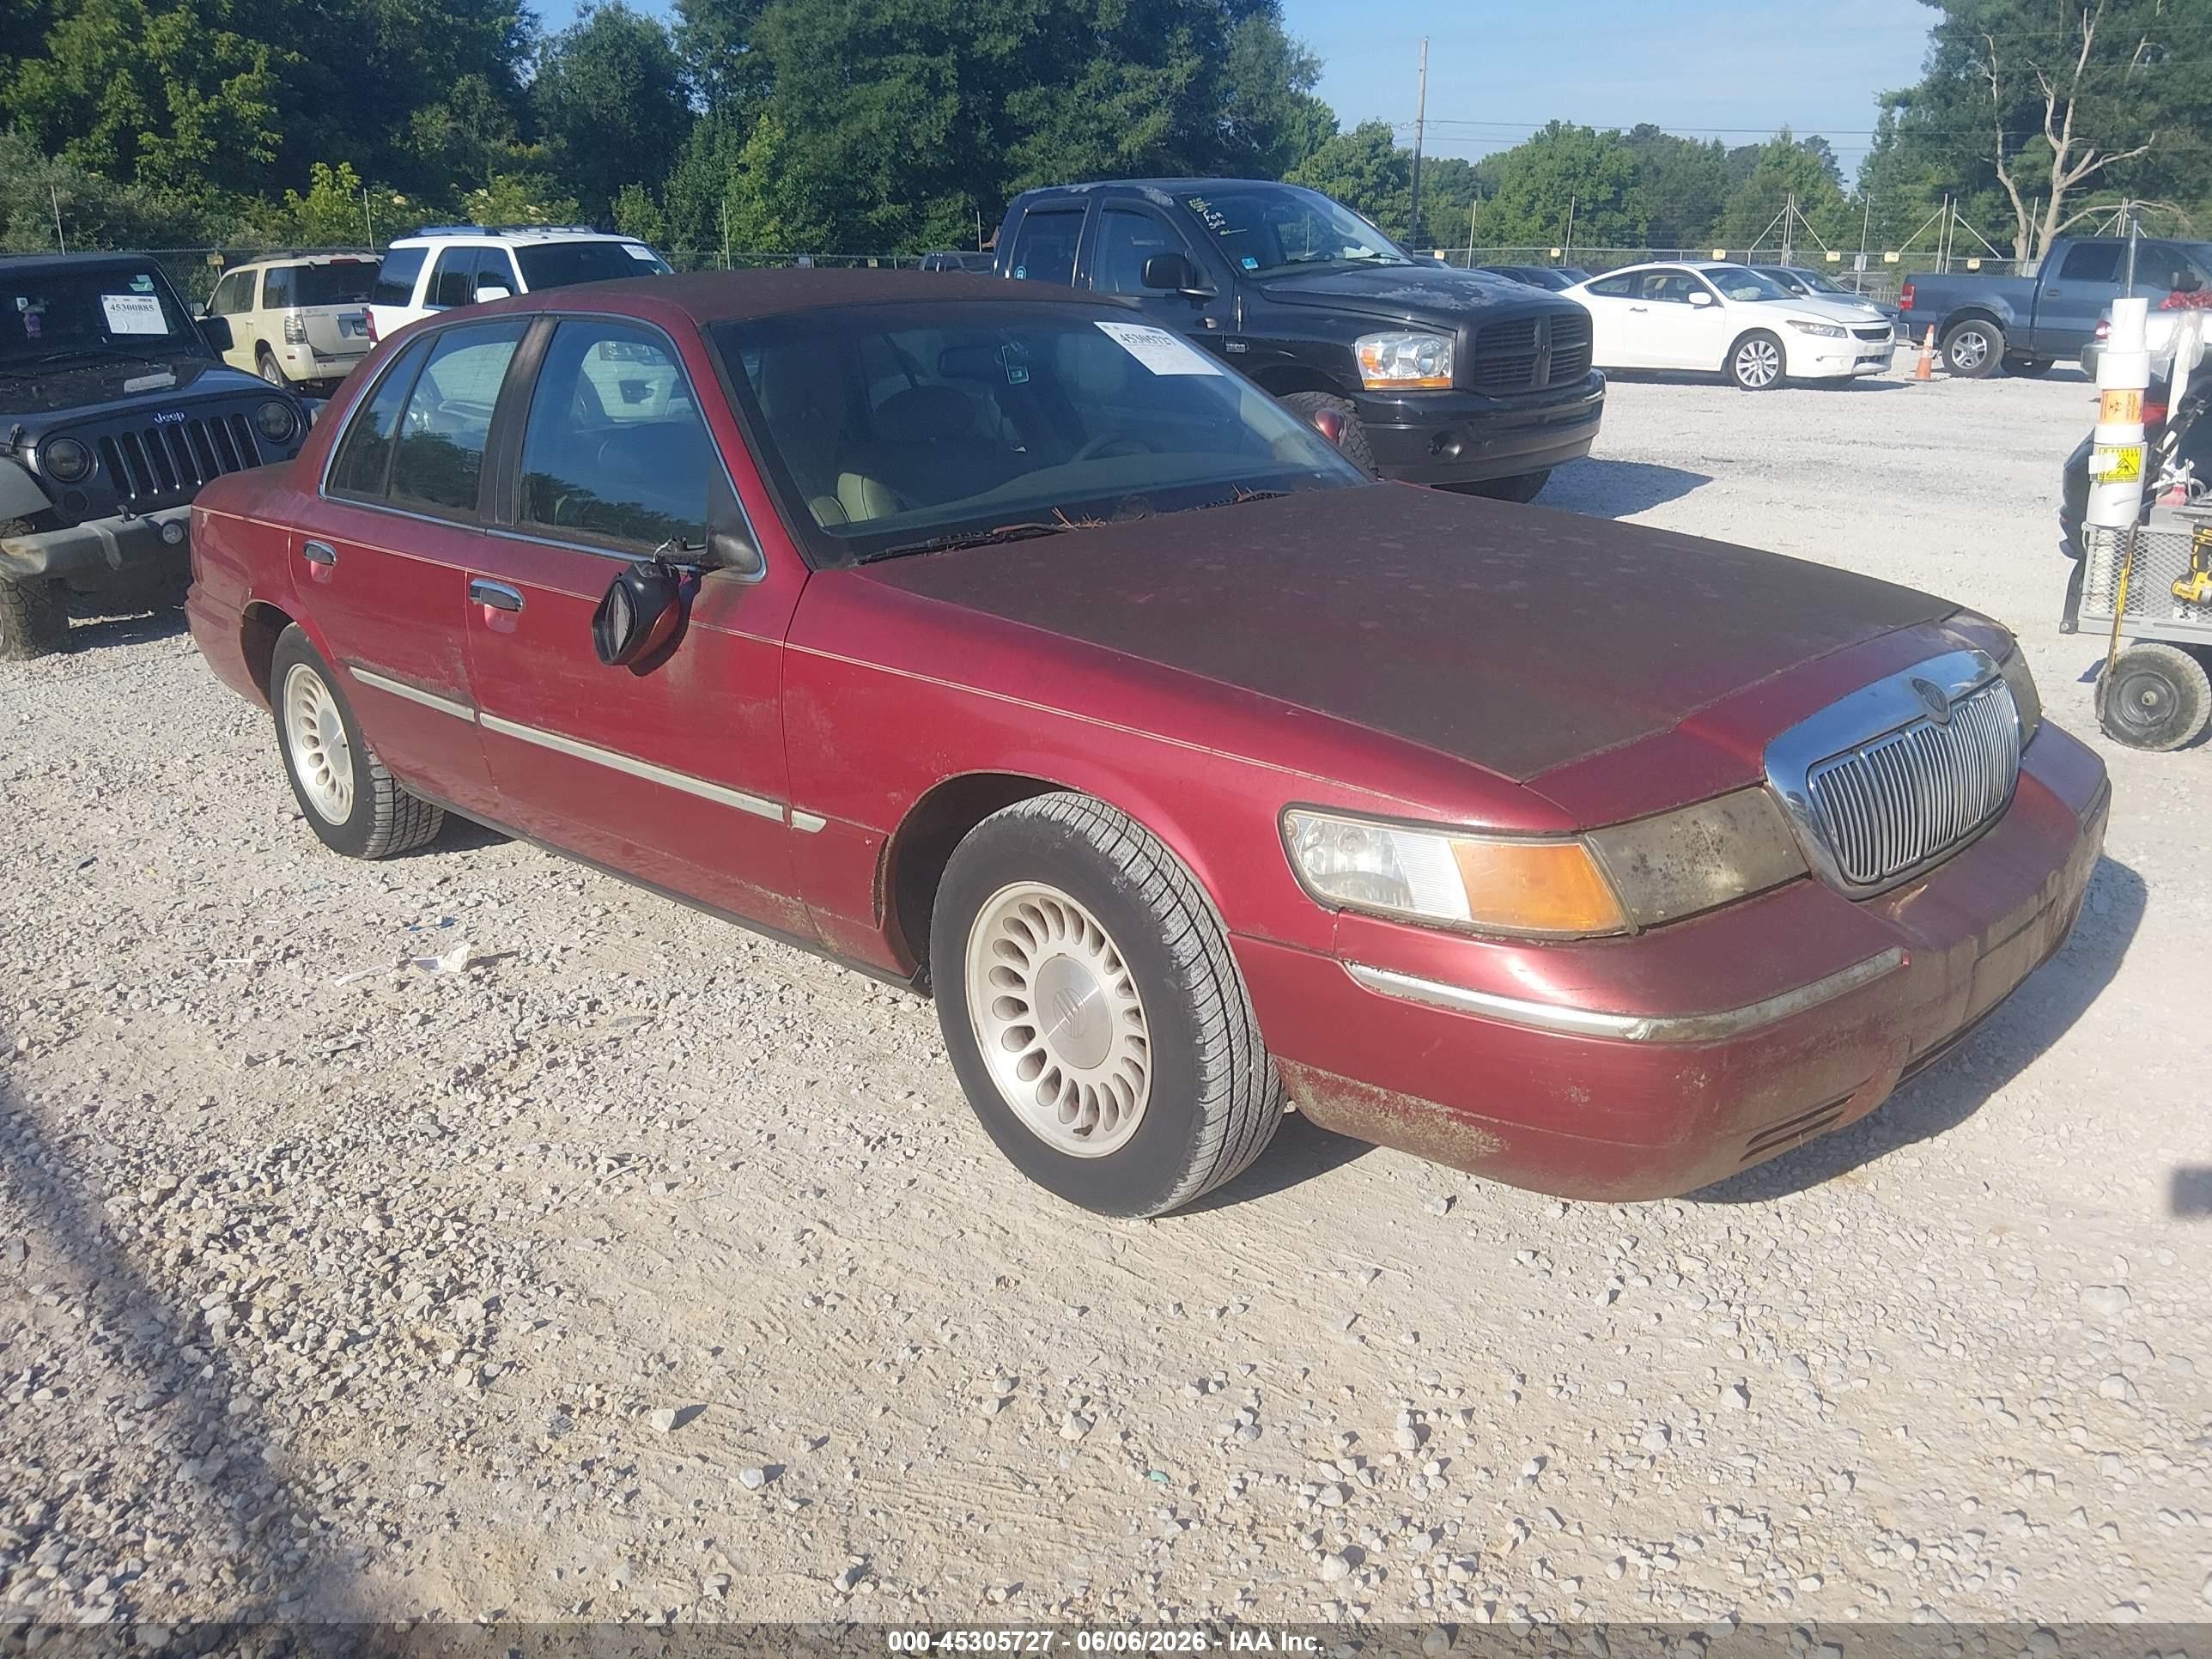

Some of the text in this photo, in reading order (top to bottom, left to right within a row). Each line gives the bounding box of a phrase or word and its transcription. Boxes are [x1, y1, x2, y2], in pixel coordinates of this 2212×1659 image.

[110, 303, 155, 312] 45300885
[1119, 333, 1177, 346] 45305727
[154, 412, 185, 423] Jeep
